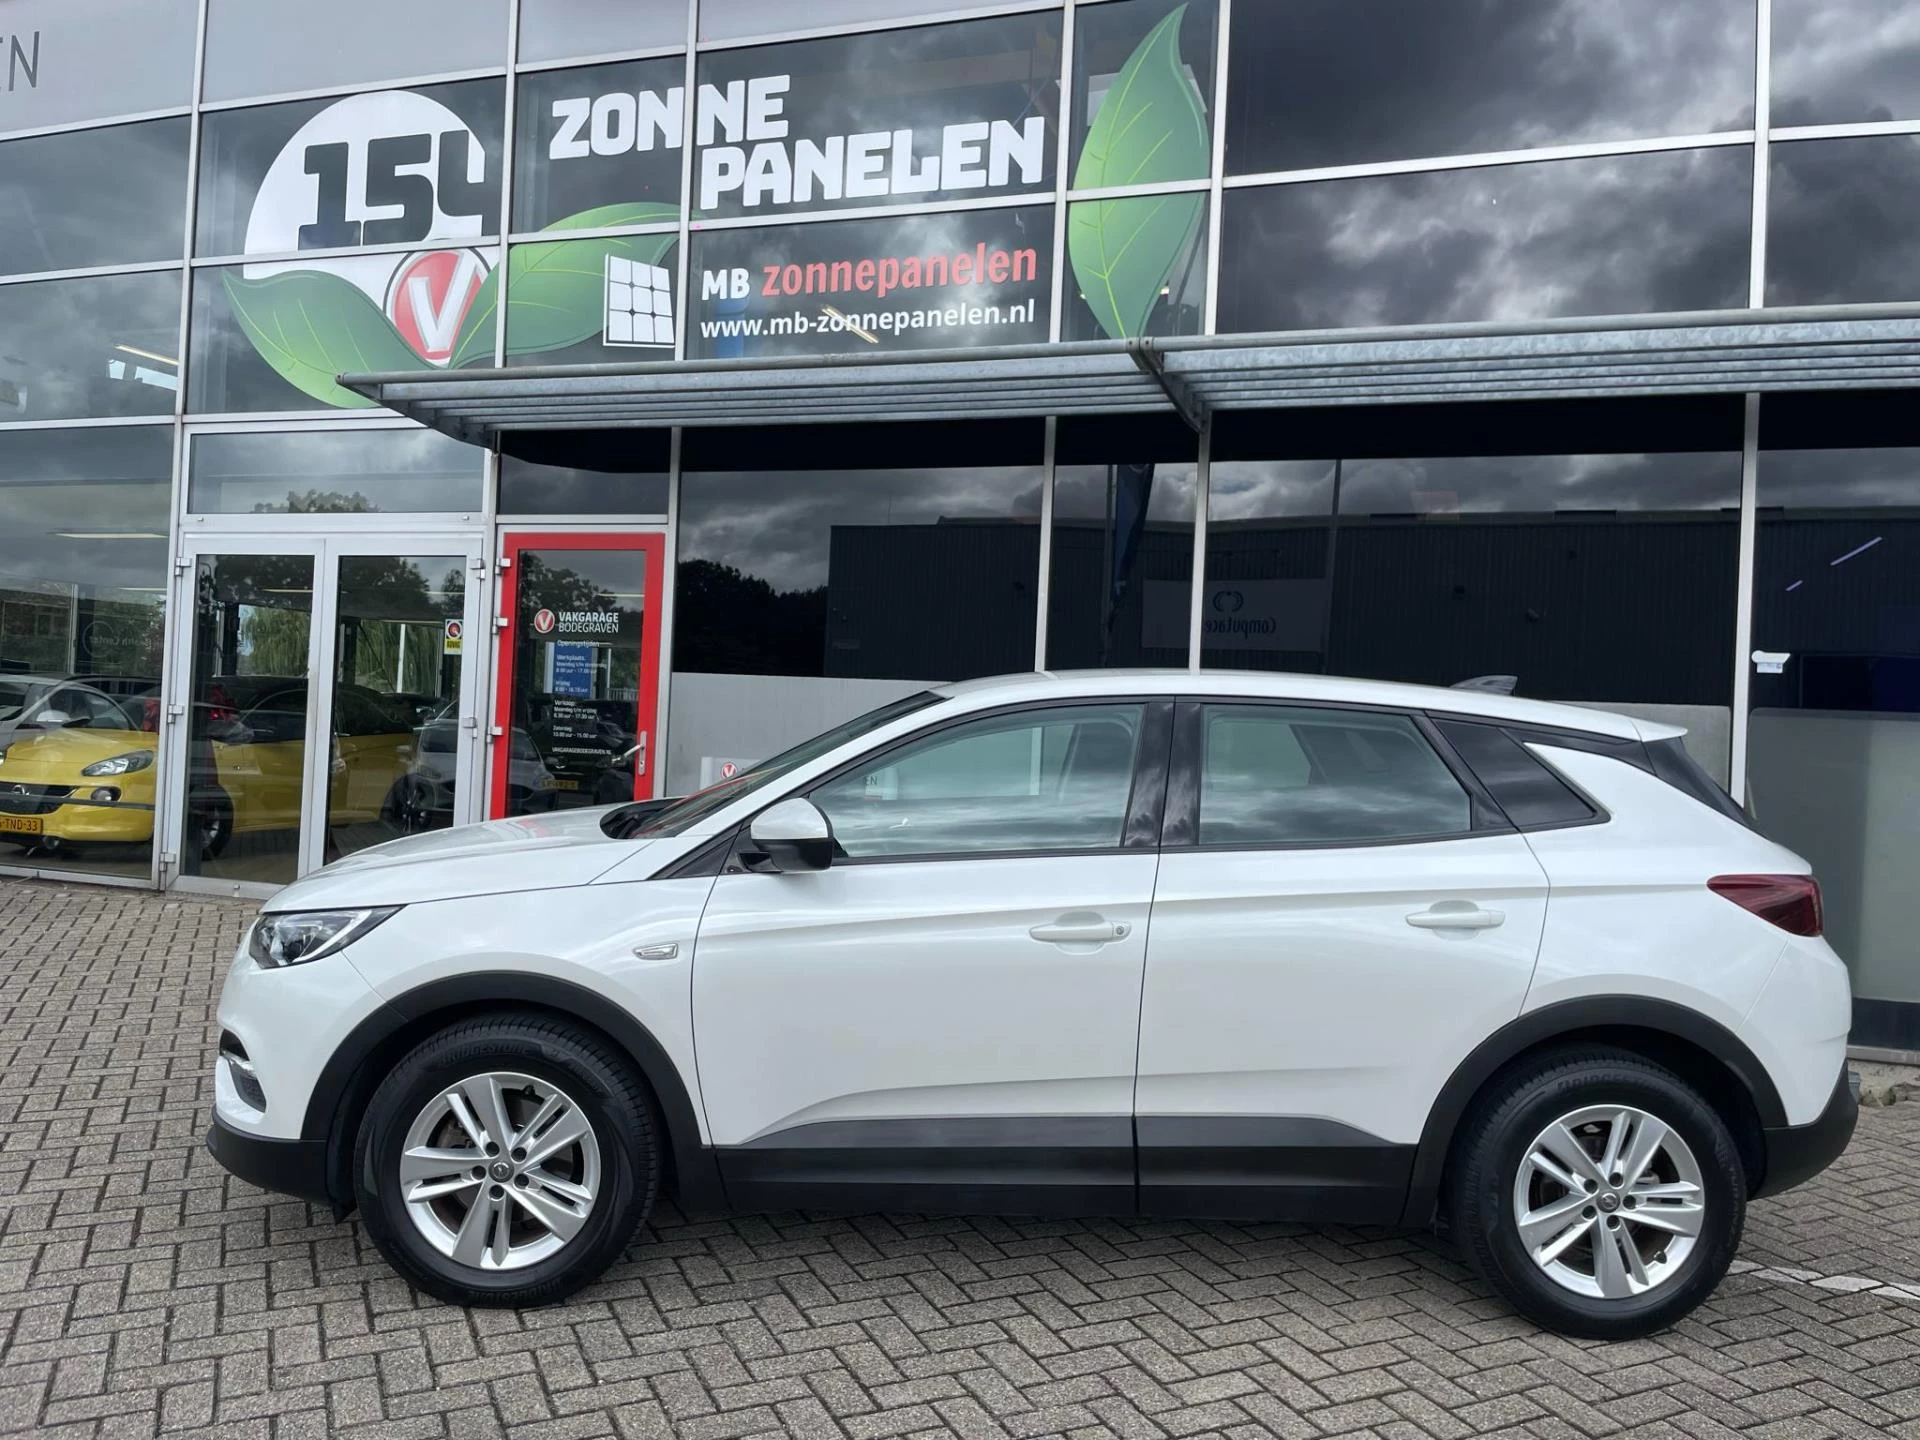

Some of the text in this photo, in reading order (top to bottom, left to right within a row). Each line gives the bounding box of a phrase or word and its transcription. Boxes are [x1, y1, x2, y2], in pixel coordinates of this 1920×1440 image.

[0, 31, 40, 92] N
[549, 74, 791, 160] ZONNE
[298, 129, 489, 250] 154
[700, 116, 1046, 210] PANELEN
[701, 242, 1037, 302] MB zonnepanelen
[700, 298, 1036, 339] www.mb-zonnepanelen.nl
[558, 611, 619, 622] VAKGARAGE
[558, 622, 619, 633] BODEGRAVEN
